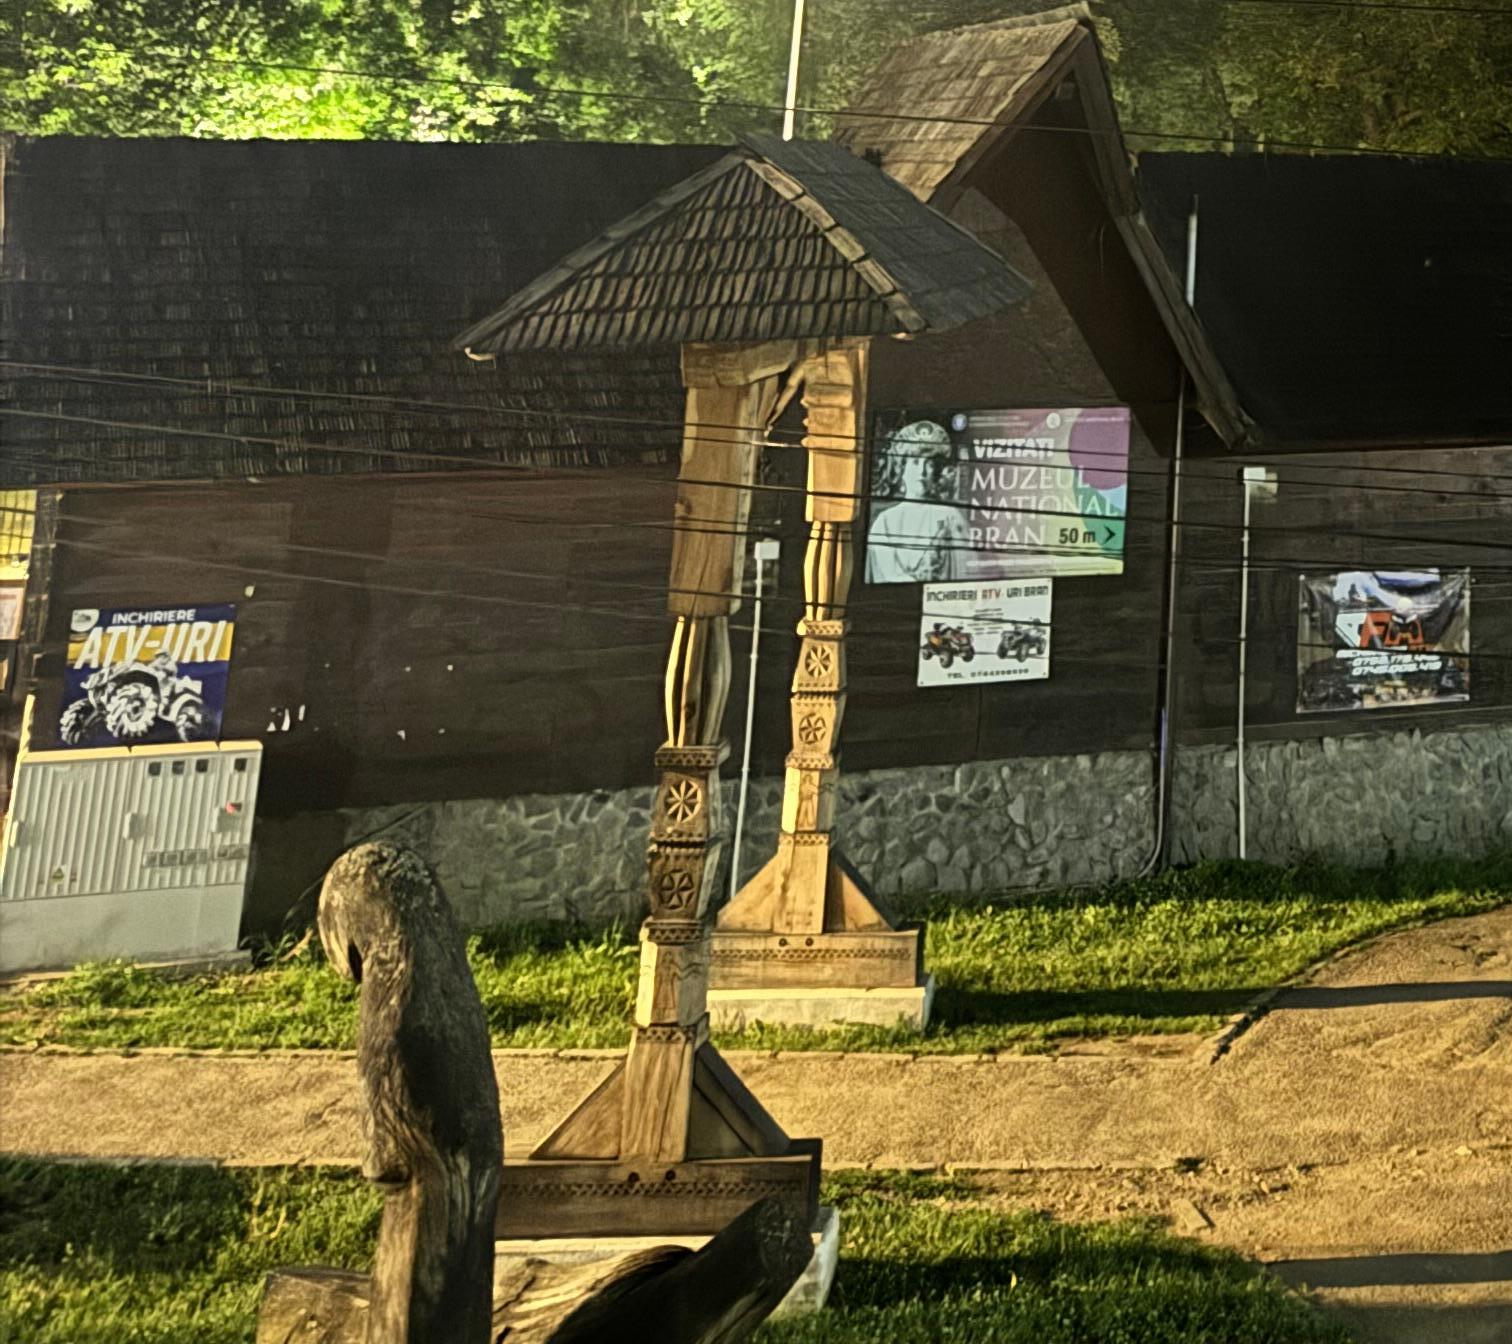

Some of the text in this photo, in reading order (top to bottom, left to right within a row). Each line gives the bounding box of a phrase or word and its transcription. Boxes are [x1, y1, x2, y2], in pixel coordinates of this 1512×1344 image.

[971, 465, 1090, 491] MUZEUL
[969, 525, 1045, 550] BRAN
[1059, 528, 1096, 544] 50 m
[112, 609, 197, 625] INCHIRIERE
[73, 620, 227, 670] ATV-URI
